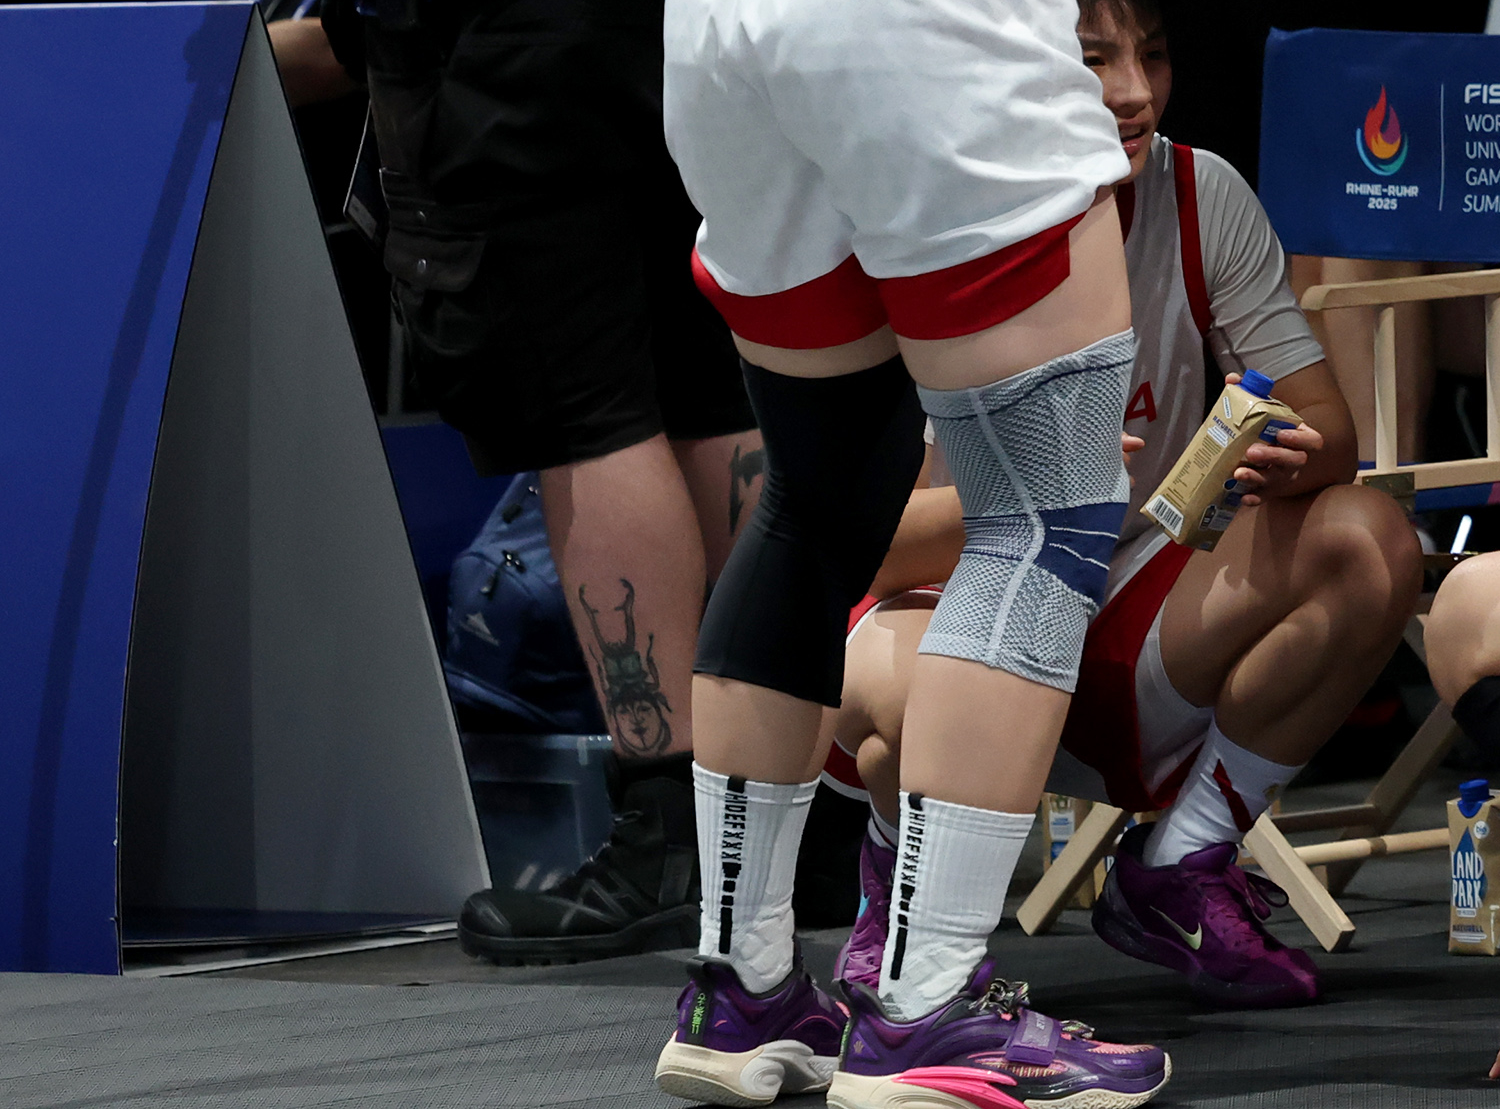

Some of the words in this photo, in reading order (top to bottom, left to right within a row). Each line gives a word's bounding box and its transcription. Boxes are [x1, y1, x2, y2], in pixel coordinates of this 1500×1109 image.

[1345, 181, 1419, 198] RHINE-RUHR
[1367, 197, 1398, 211] 2025
[1450, 850, 1485, 880] LAND
[1452, 878, 1483, 909] PARK
